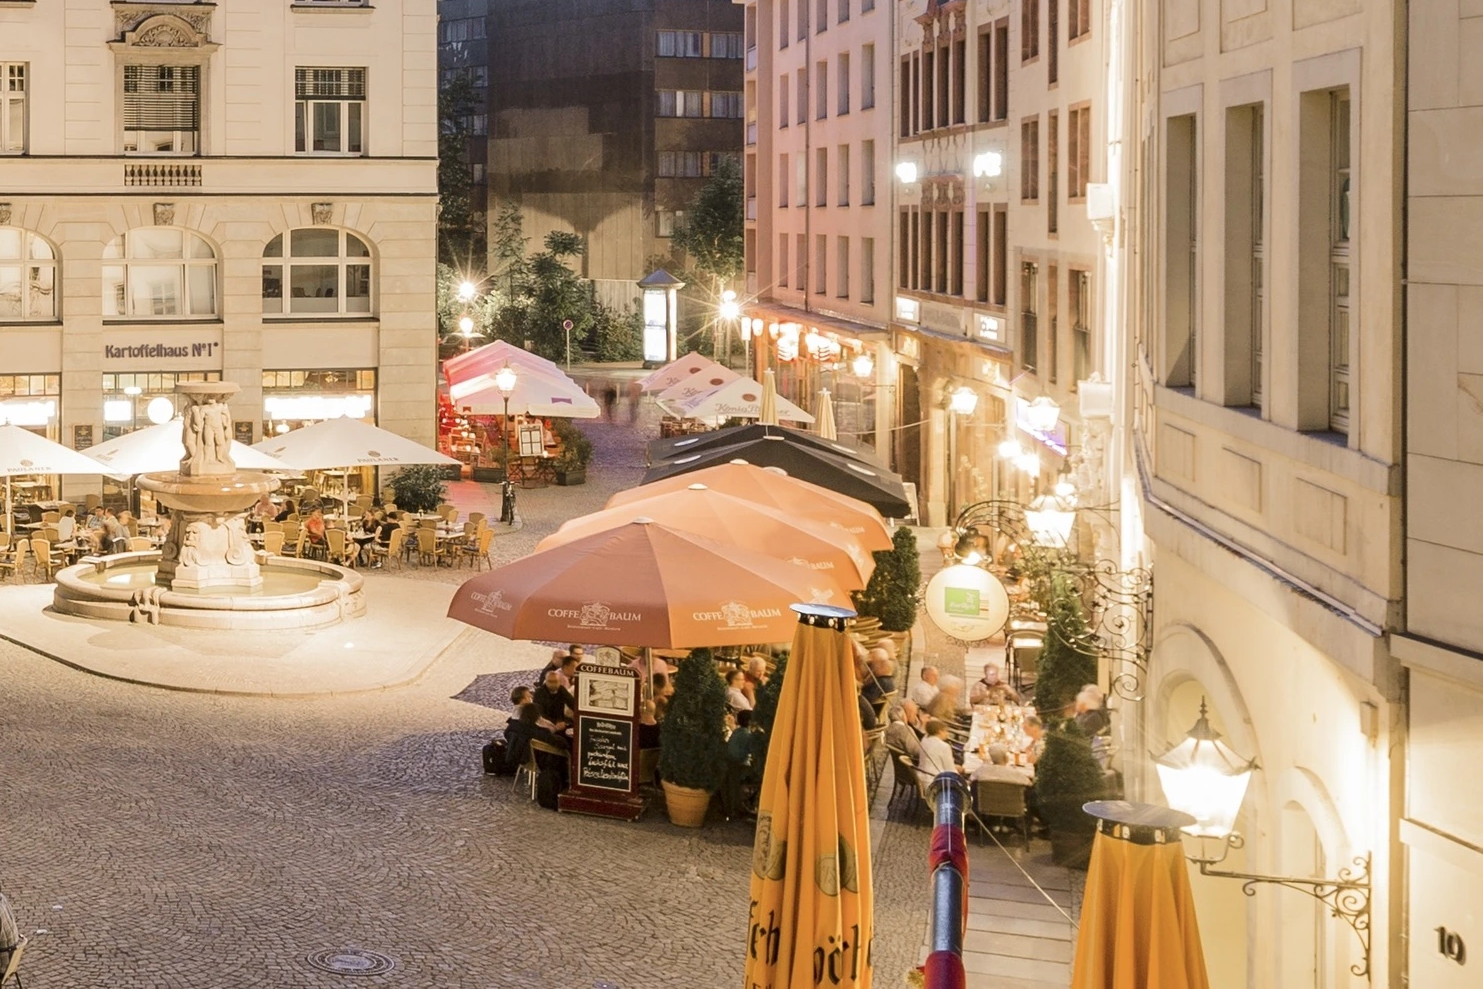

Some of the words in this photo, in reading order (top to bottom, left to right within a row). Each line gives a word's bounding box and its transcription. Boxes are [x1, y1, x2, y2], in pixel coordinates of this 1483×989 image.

[105, 343, 189, 359] Kartoffelhaus
[547, 608, 580, 619] COFFE
[610, 612, 642, 622] BAUM
[692, 611, 724, 621] COFFE
[751, 608, 782, 619] BAUM
[580, 664, 635, 677] COFFEBAUM
